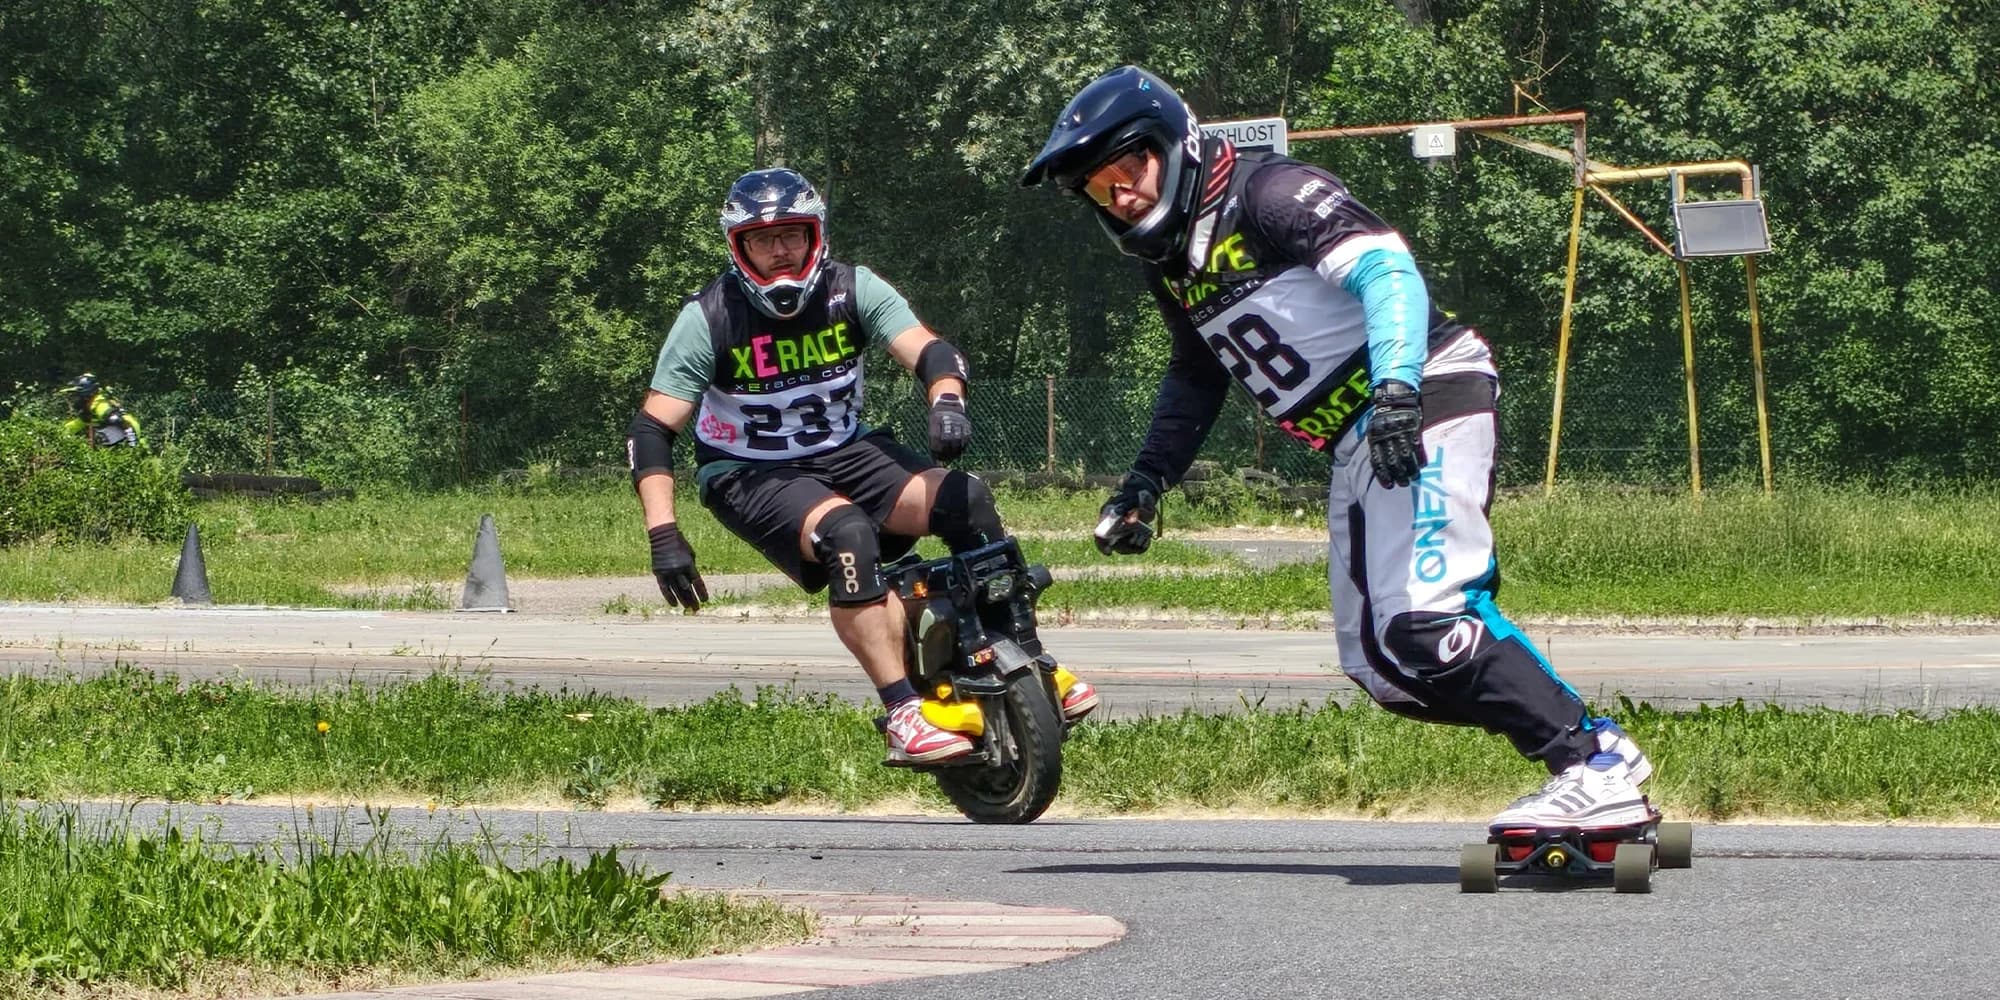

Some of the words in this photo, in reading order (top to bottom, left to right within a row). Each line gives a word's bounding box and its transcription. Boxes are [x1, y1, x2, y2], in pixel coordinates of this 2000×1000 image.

[1292, 179, 1326, 204] MSR
[731, 322, 856, 380] XERACE
[1207, 312, 1310, 409] 28
[738, 376, 857, 451] 237
